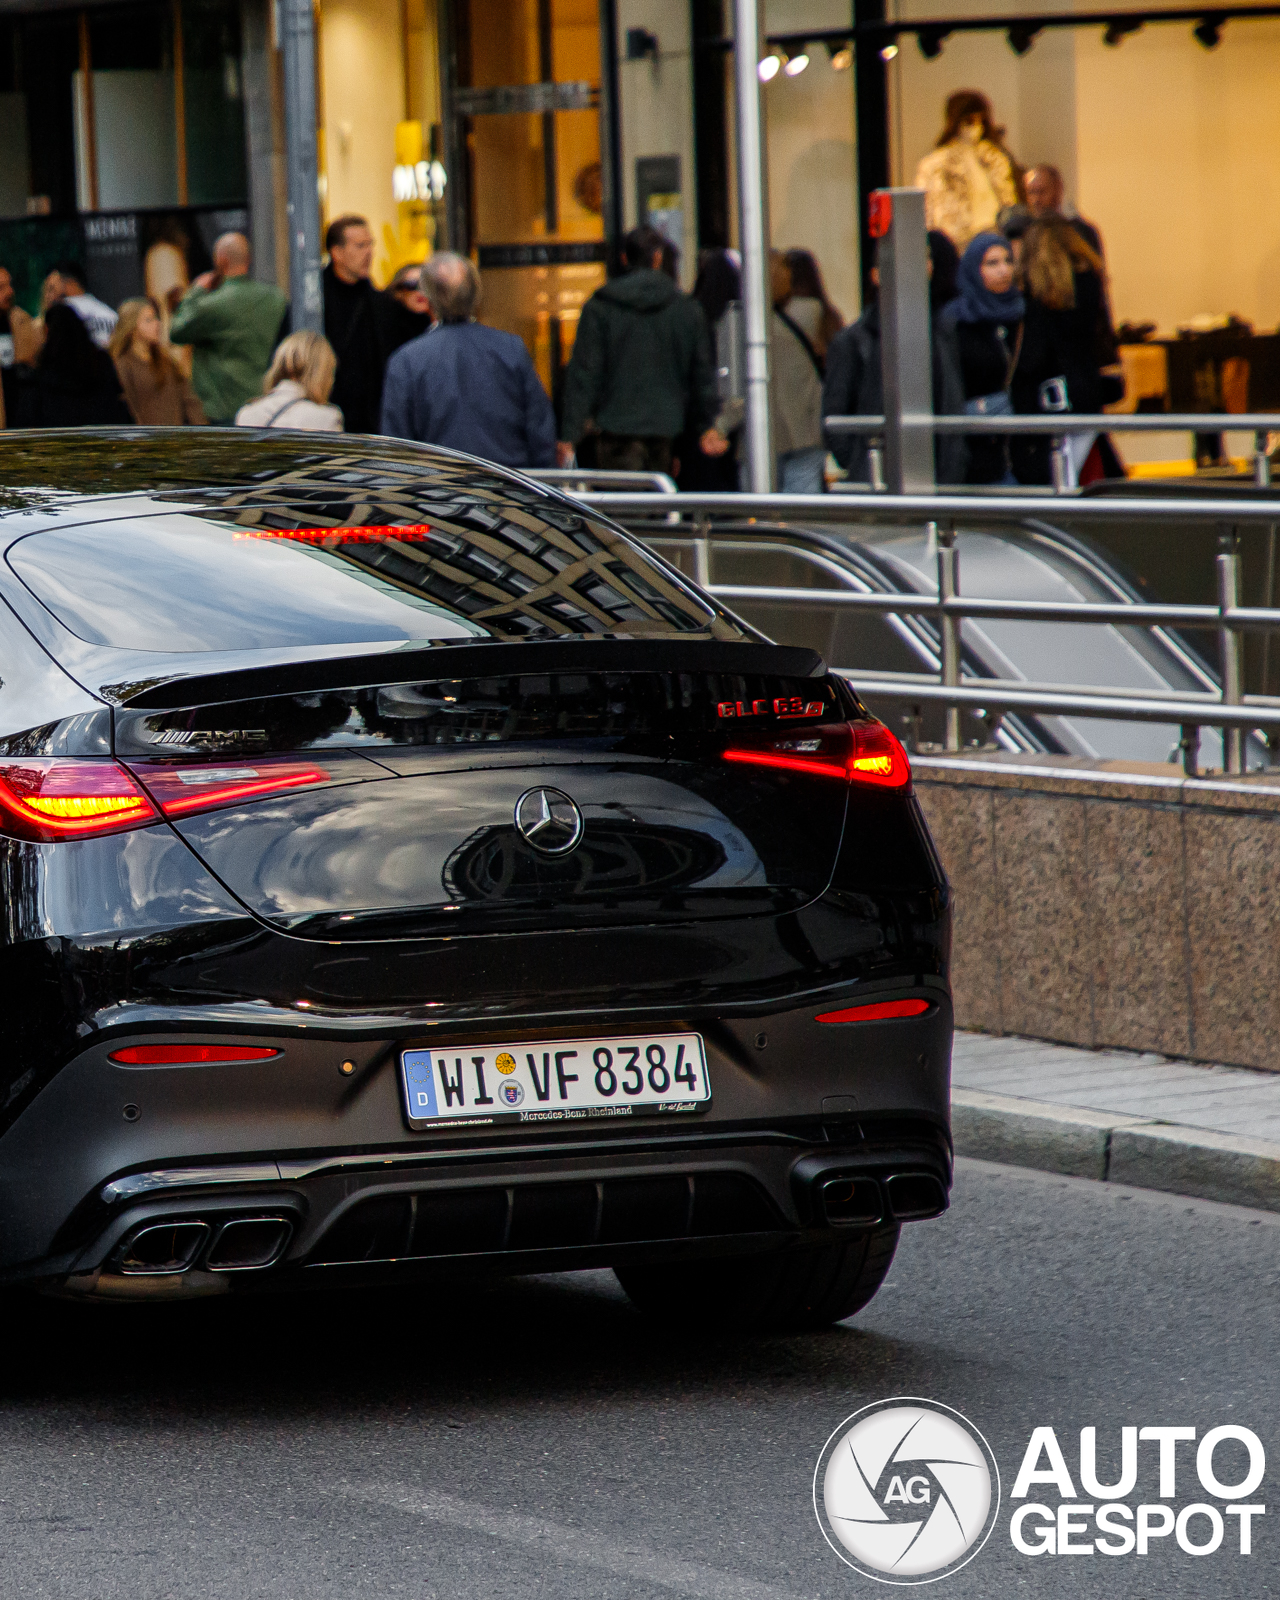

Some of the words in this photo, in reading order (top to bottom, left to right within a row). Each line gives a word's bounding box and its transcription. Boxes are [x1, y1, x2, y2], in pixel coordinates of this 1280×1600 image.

[718, 700, 769, 717] GLC
[186, 729, 268, 743] AMG
[417, 1092, 429, 1106] D
[438, 1057, 493, 1107] WI
[526, 1051, 579, 1101] VF
[592, 1044, 697, 1097] 8384
[520, 1108, 587, 1121] Mercedes-Benz
[588, 1105, 632, 1117] Rheinland
